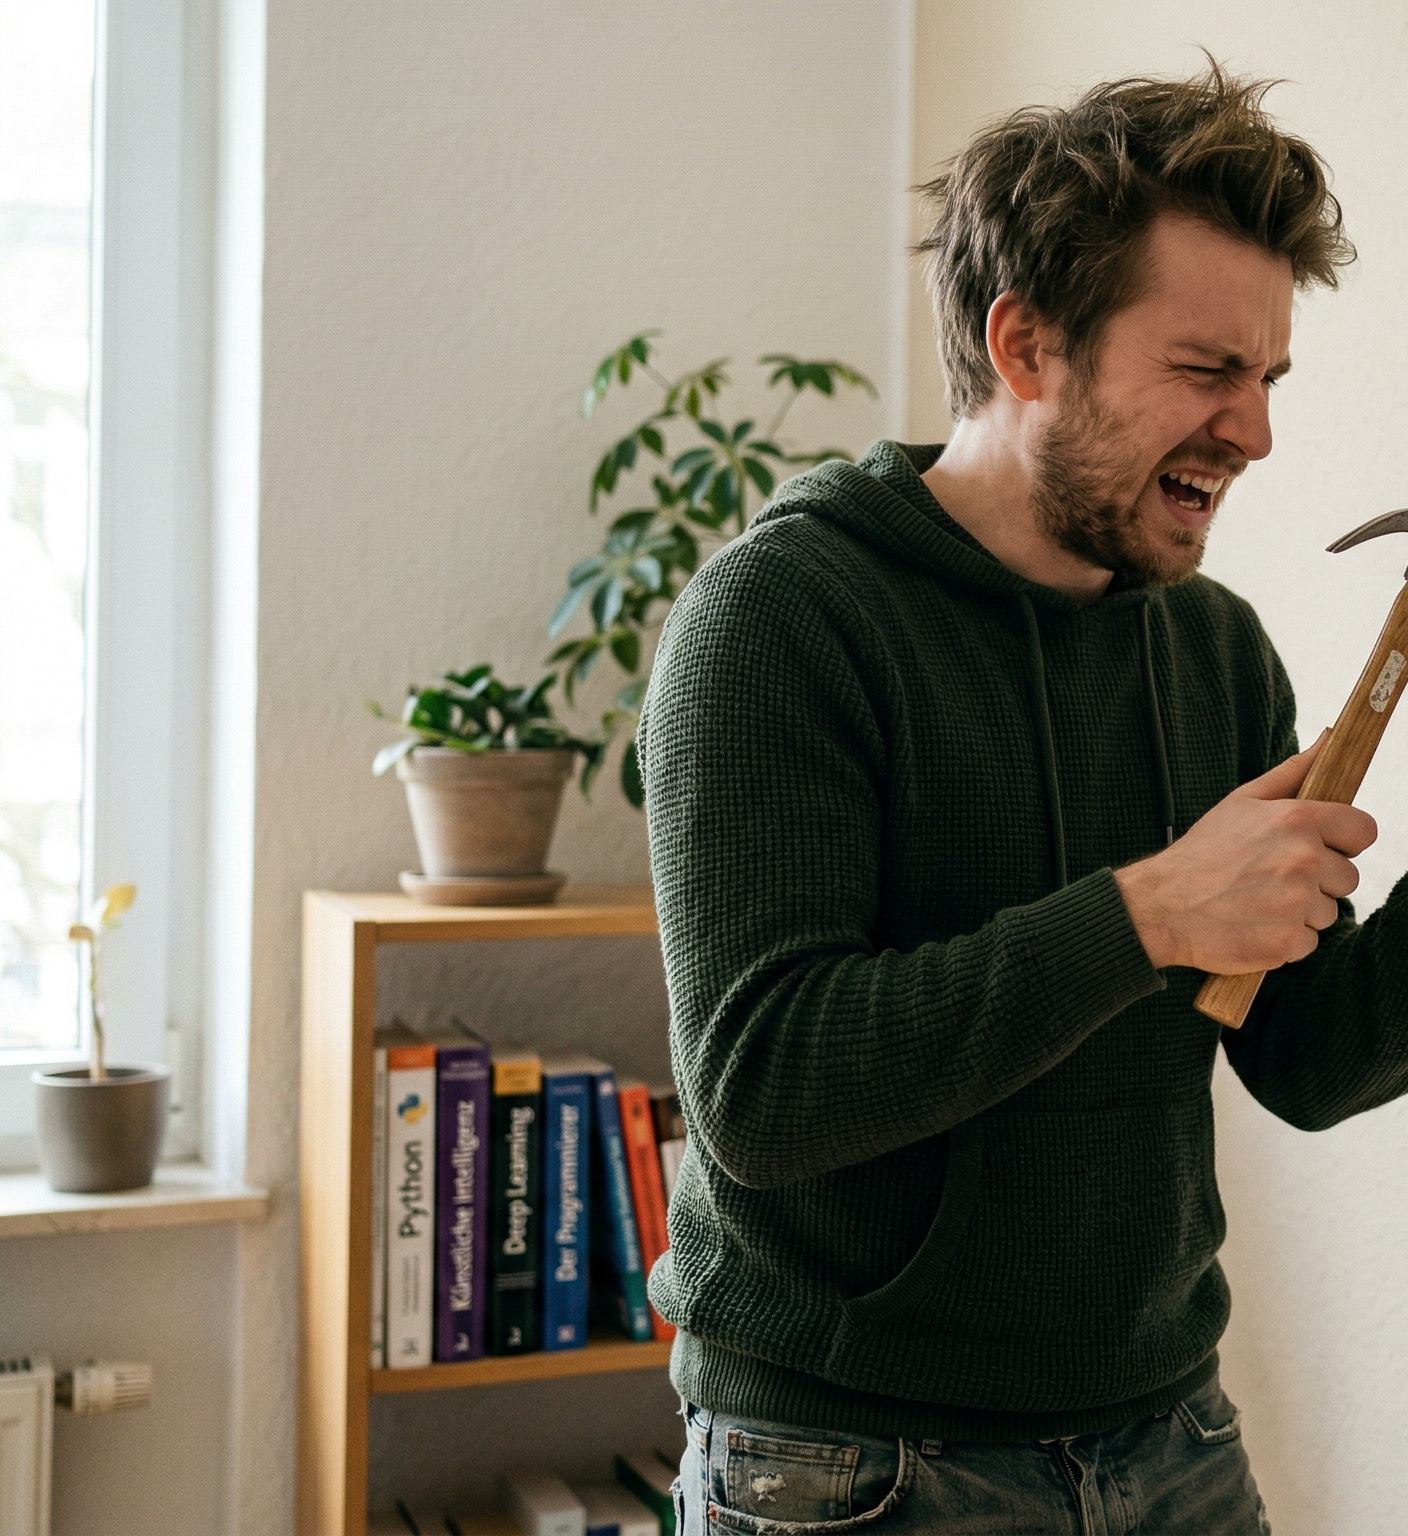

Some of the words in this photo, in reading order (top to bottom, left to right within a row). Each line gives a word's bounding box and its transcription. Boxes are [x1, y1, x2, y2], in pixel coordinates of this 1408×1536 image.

[399, 1139, 429, 1240] Python
[502, 1199, 533, 1256] Deep
[554, 1248, 579, 1283] Der
